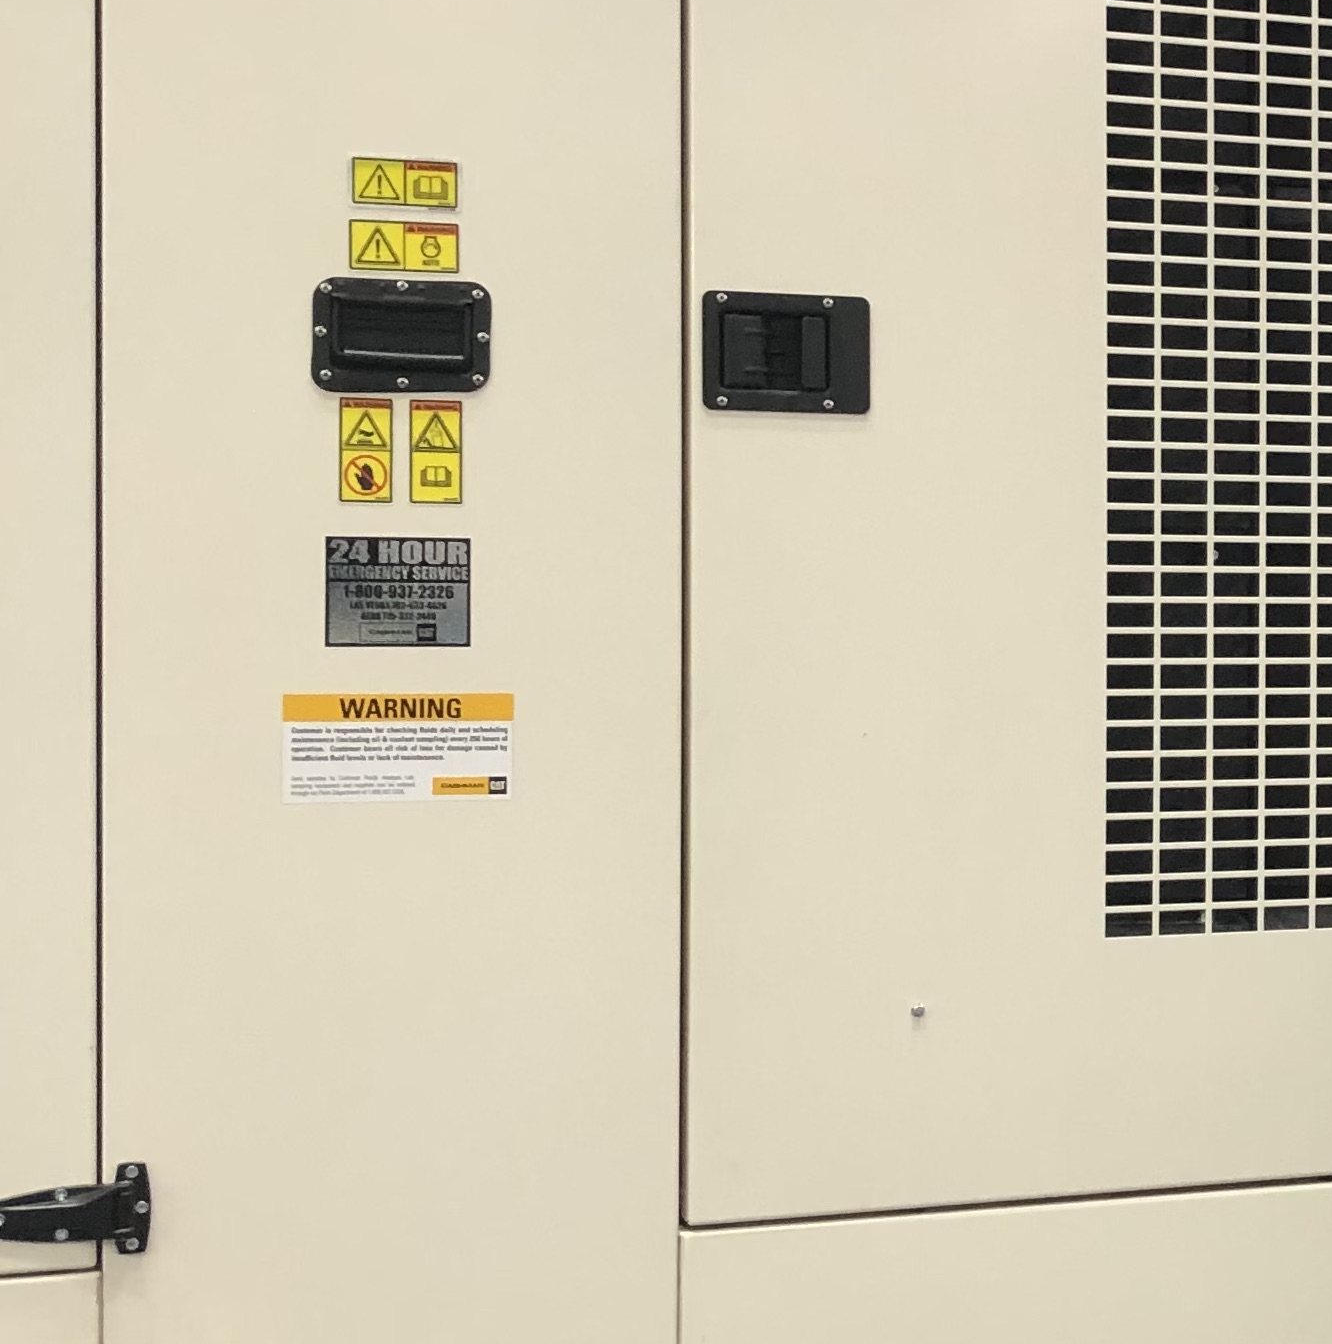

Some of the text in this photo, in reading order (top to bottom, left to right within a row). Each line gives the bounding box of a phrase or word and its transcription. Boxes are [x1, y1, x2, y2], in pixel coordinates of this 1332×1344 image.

[328, 538, 468, 565] 24 HOUR
[329, 564, 469, 581] EMERGENCY SERVICE
[339, 697, 462, 719] WARNING
